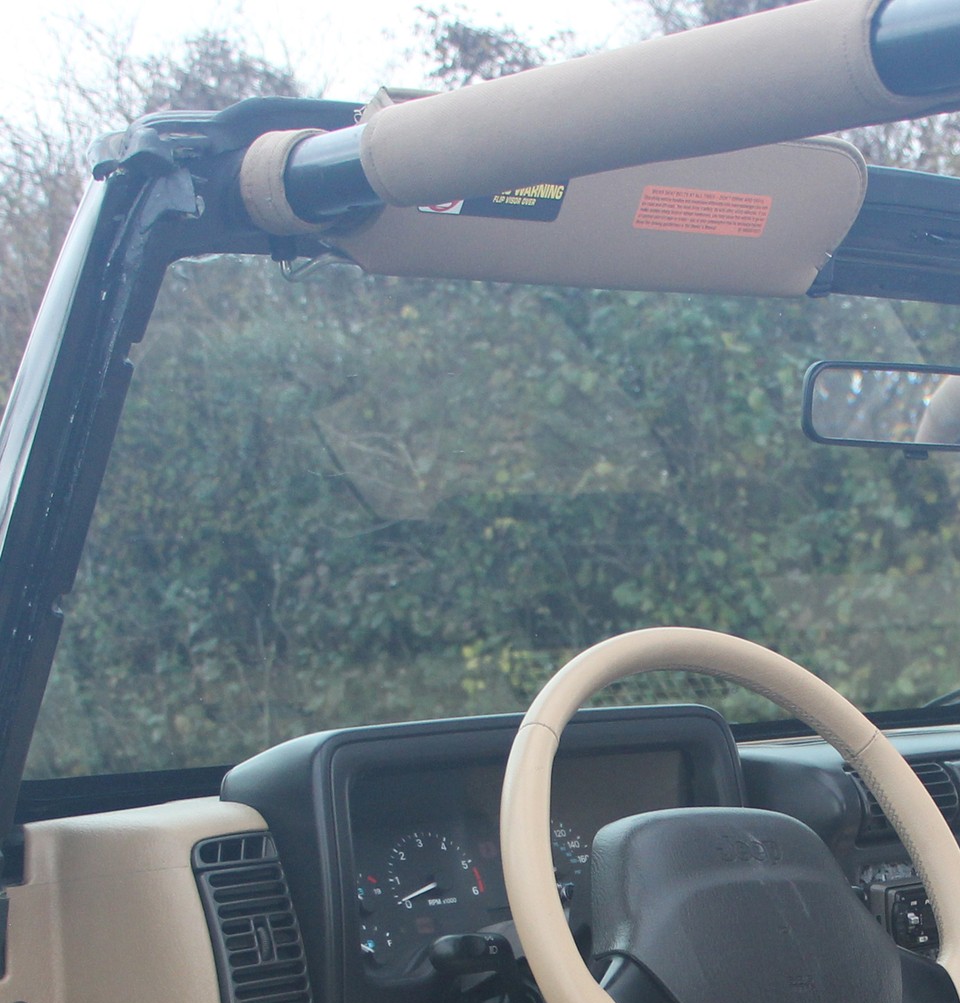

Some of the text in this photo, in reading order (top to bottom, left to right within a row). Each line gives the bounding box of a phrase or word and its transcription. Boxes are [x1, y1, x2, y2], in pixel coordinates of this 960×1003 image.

[515, 184, 564, 200] WARNING
[493, 195, 537, 206] FLIP VISOR OVER
[554, 829, 566, 838] 120
[416, 838, 424, 848] 3
[441, 842, 447, 851] 4
[567, 840, 580, 849] 140
[716, 835, 782, 866] Jeep
[398, 851, 406, 861] 2
[461, 860, 469, 870] 5
[395, 876, 401, 885] 1
[471, 886, 480, 896] 6
[404, 900, 413, 909] 0
[428, 897, 458, 907] RPM x1000
[387, 939, 393, 947] F
